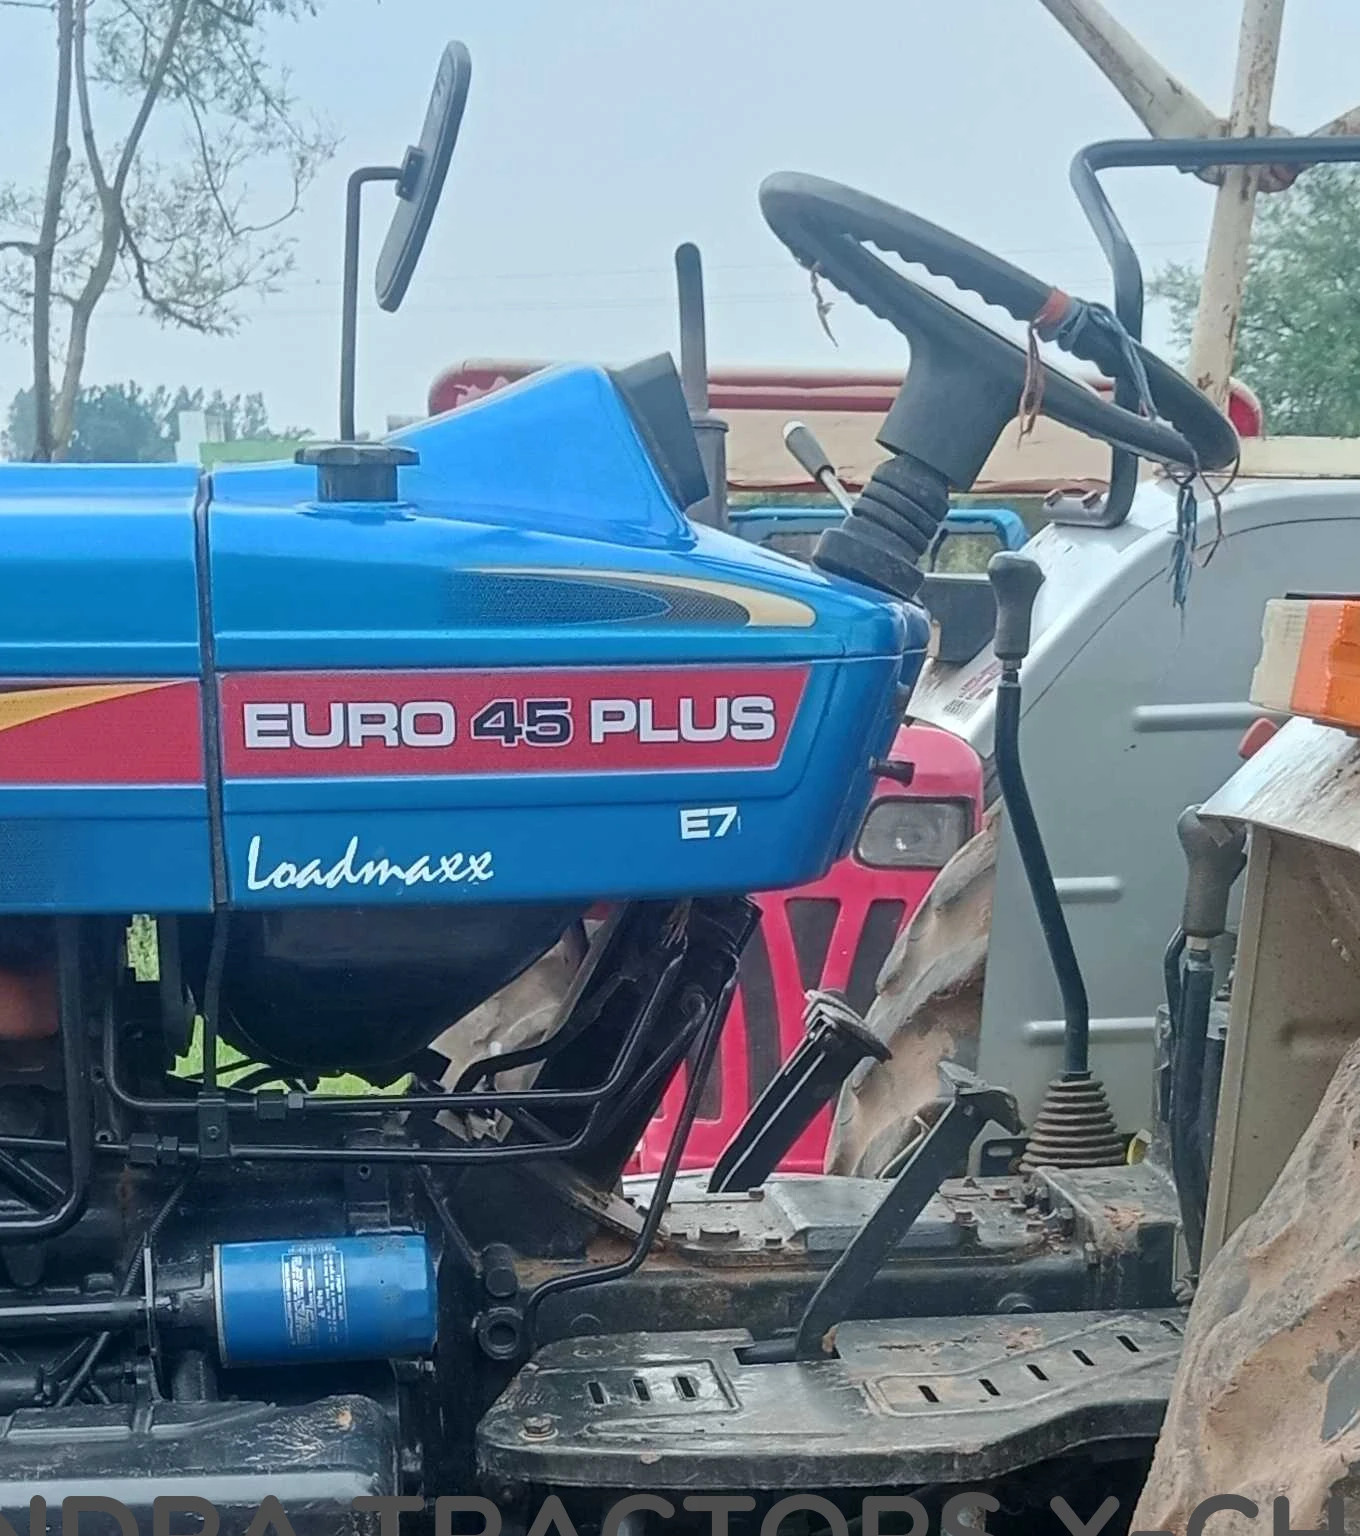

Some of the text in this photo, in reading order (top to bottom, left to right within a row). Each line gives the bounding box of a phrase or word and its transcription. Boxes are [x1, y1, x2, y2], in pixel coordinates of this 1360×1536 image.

[242, 695, 777, 750] EURO 45 PLUS
[680, 806, 738, 840] E7
[245, 834, 495, 892] Loadmaxx
